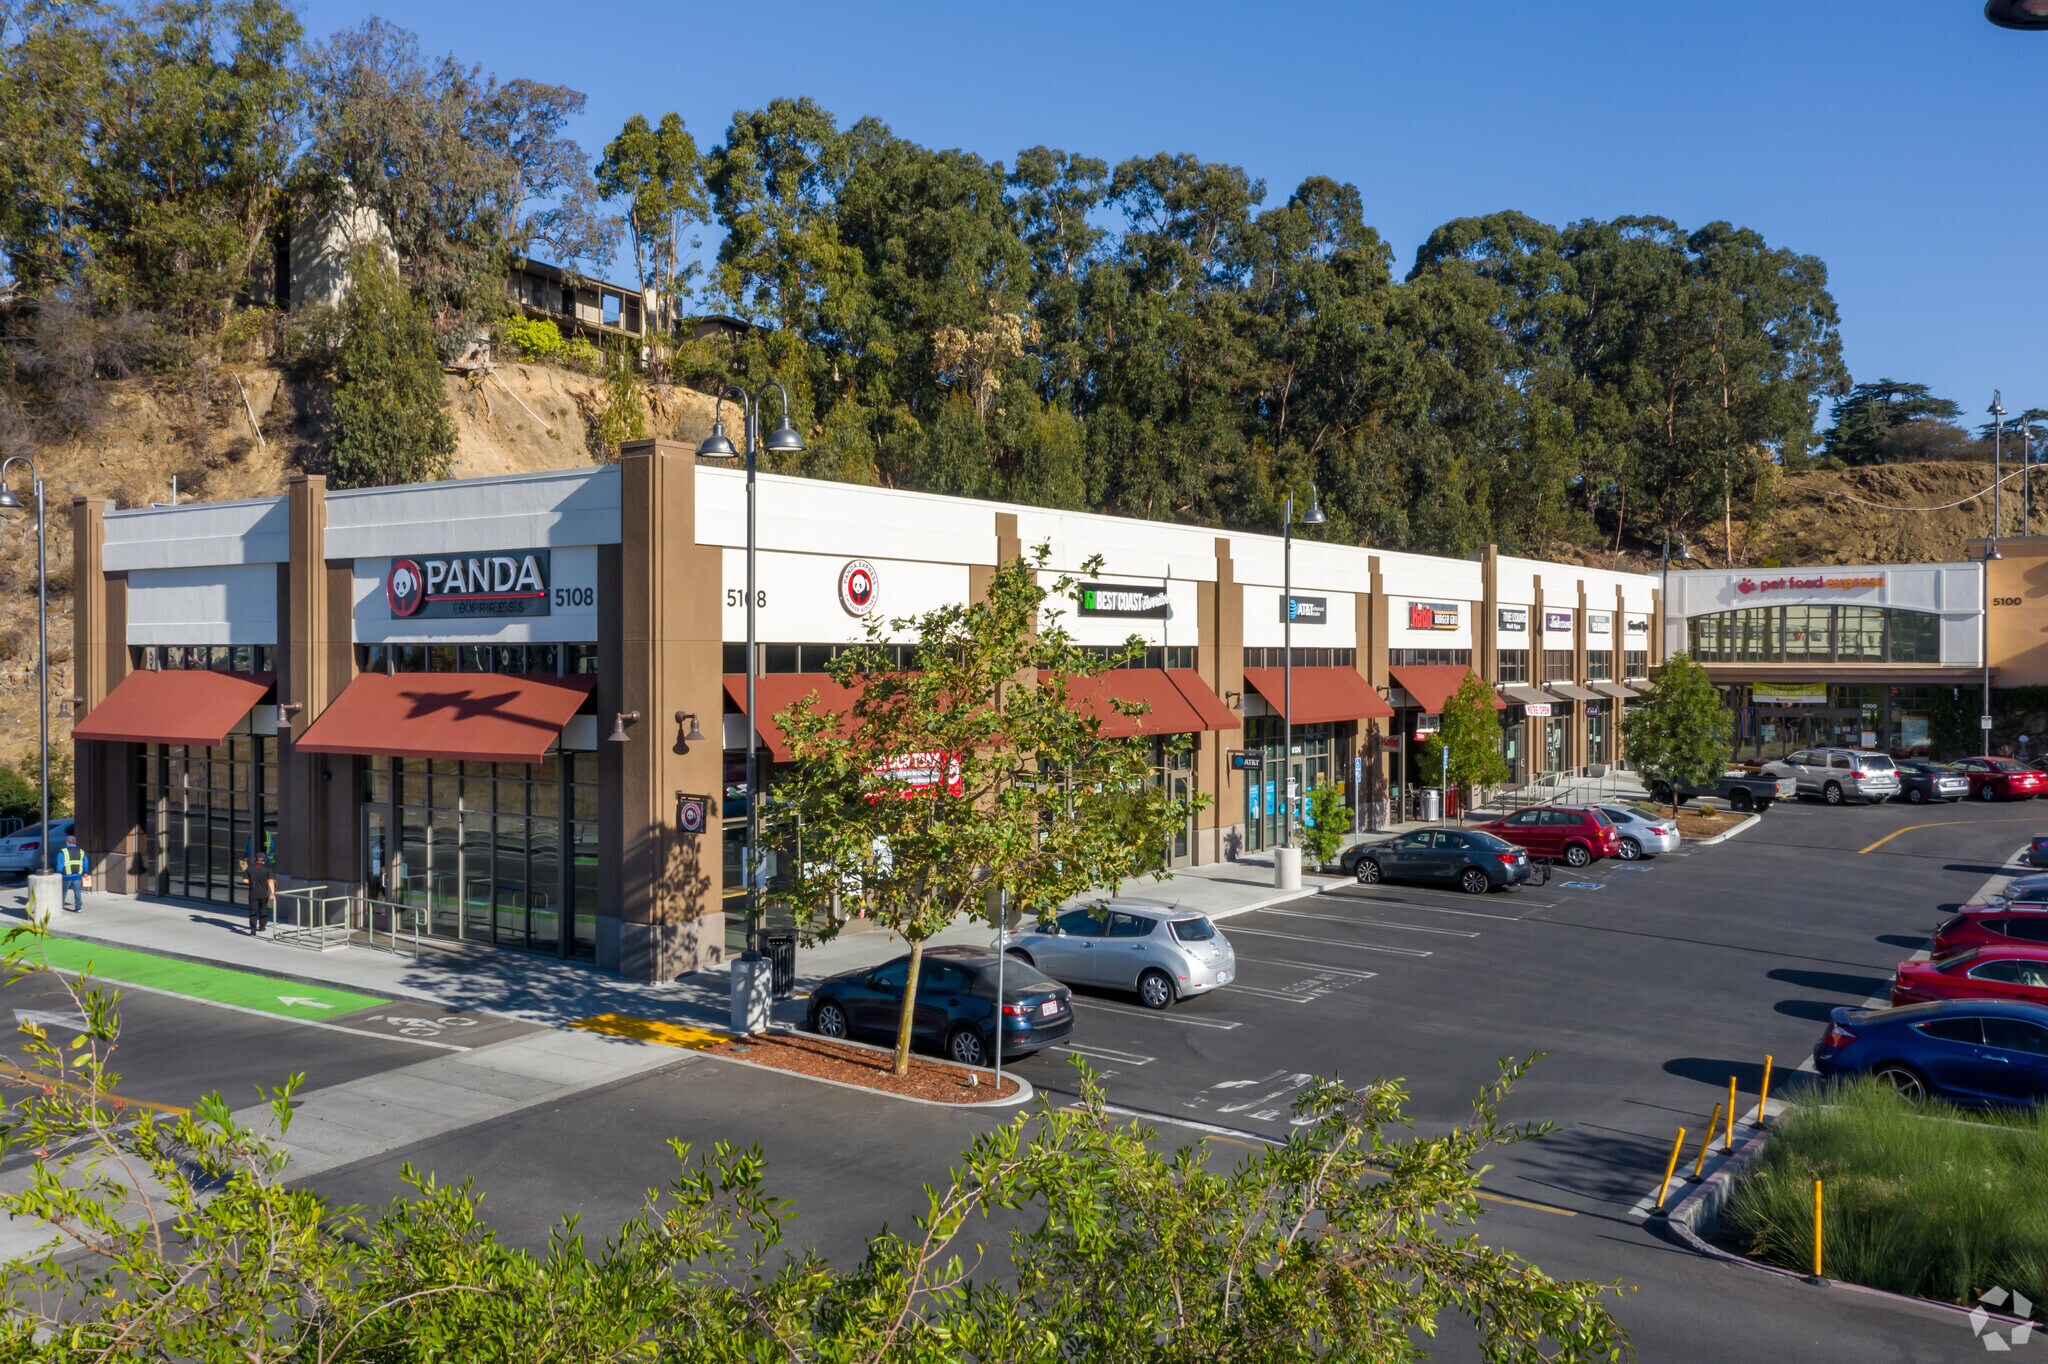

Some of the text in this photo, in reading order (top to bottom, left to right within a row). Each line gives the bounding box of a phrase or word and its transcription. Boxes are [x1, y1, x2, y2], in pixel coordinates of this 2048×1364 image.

[425, 555, 545, 594] PANDA
[843, 561, 877, 586] PANDA EXPRESS
[1760, 576, 1886, 593] pet food express
[555, 587, 594, 608] 5108
[726, 588, 768, 609] 518
[1096, 591, 1117, 610] BEST
[1117, 592, 1142, 611] COAST
[1992, 597, 2022, 606] 5100
[1297, 603, 1314, 616] AT&T
[1243, 758, 1260, 766] AT&T
